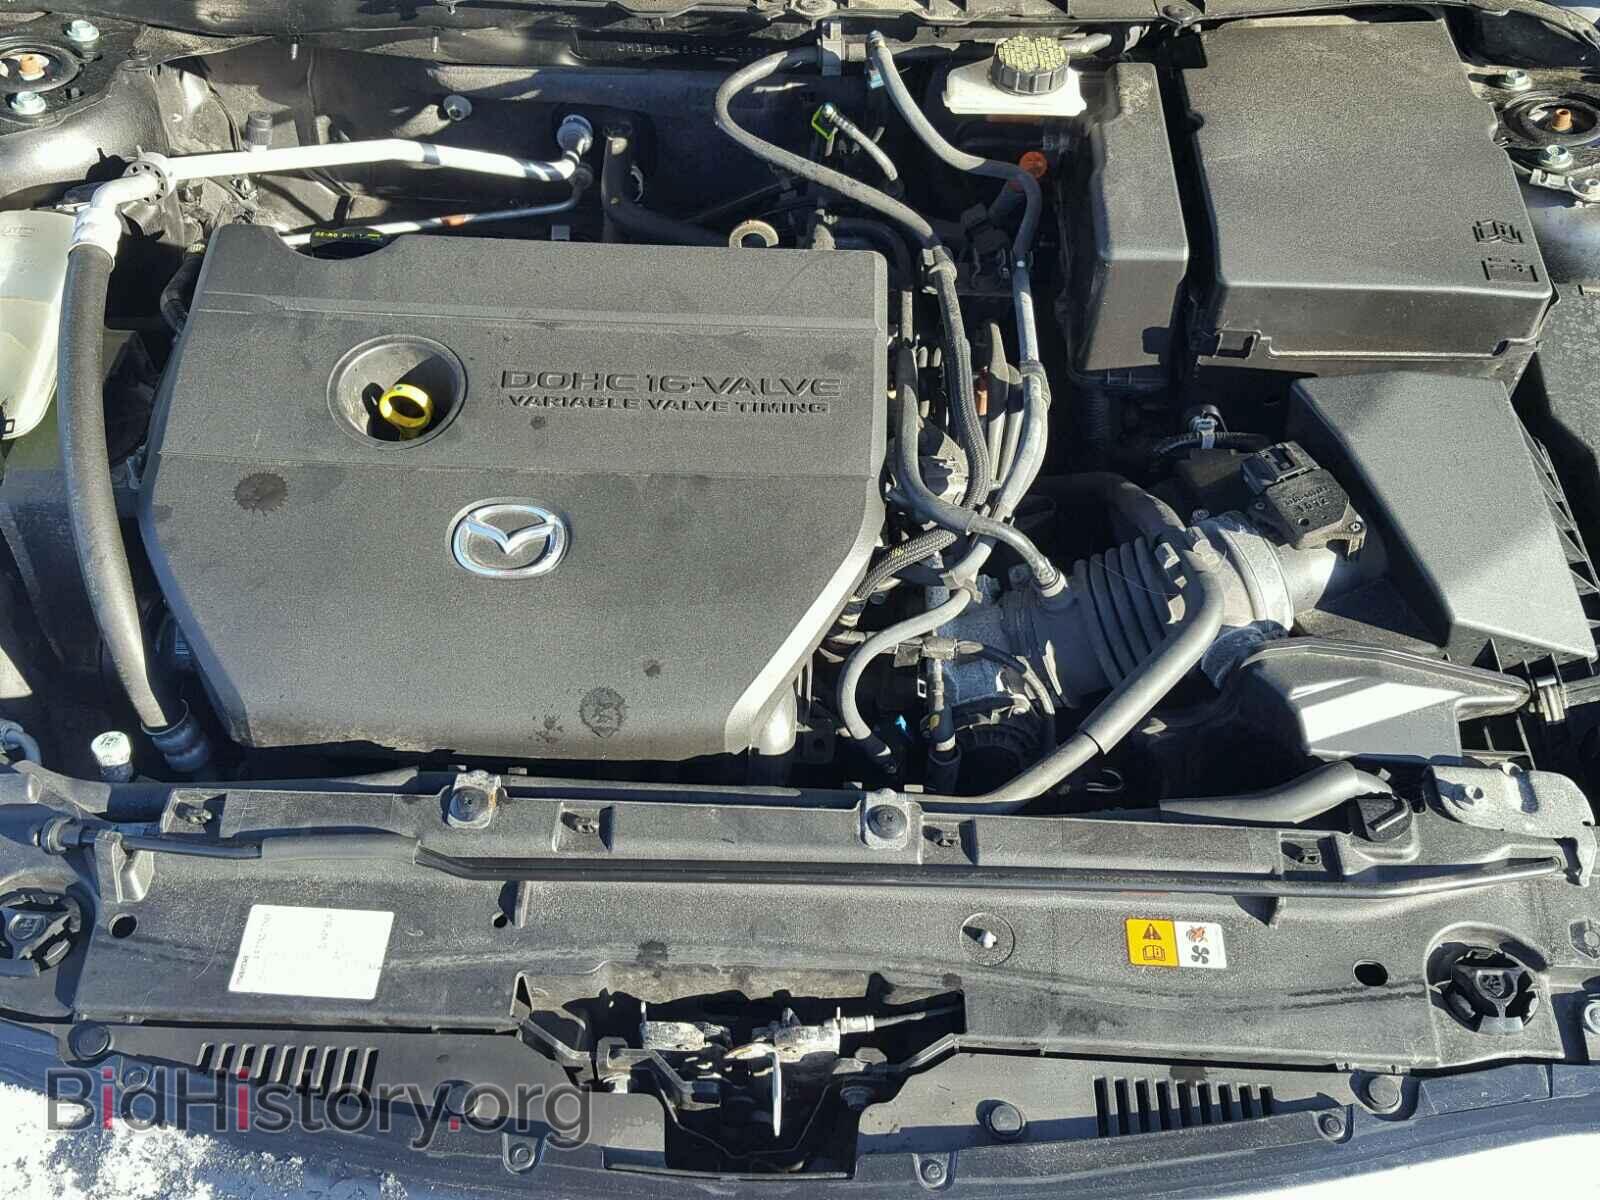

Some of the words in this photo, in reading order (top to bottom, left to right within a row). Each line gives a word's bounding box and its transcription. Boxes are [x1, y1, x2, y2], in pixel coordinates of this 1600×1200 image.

[501, 370, 638, 392] DOHC
[646, 374, 842, 397] 16-VALVE
[509, 394, 641, 410] VARIABLE
[648, 398, 730, 413] VALVE
[735, 400, 829, 415] TIMING
